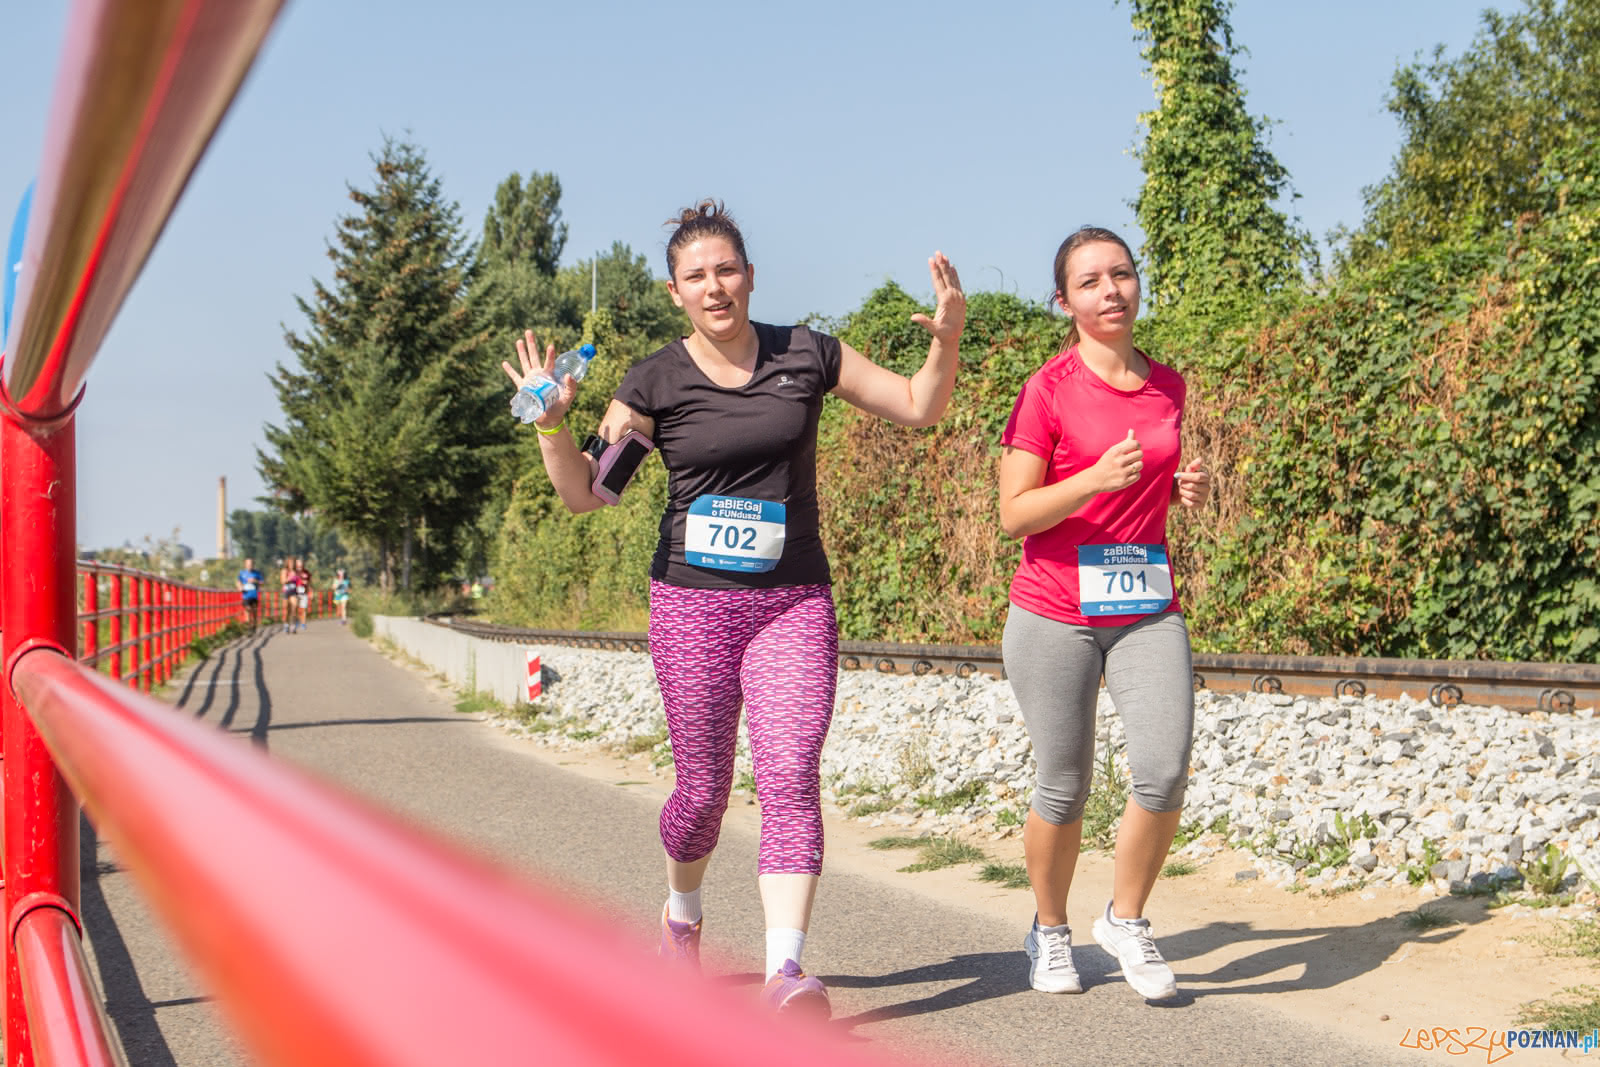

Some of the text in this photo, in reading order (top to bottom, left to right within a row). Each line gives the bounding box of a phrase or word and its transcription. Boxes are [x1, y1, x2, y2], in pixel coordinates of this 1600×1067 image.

[711, 498, 763, 514] zaBIEGaj
[708, 523, 757, 551] 702
[1103, 545, 1148, 558] zaBIEGaj
[1102, 570, 1147, 594] 701
